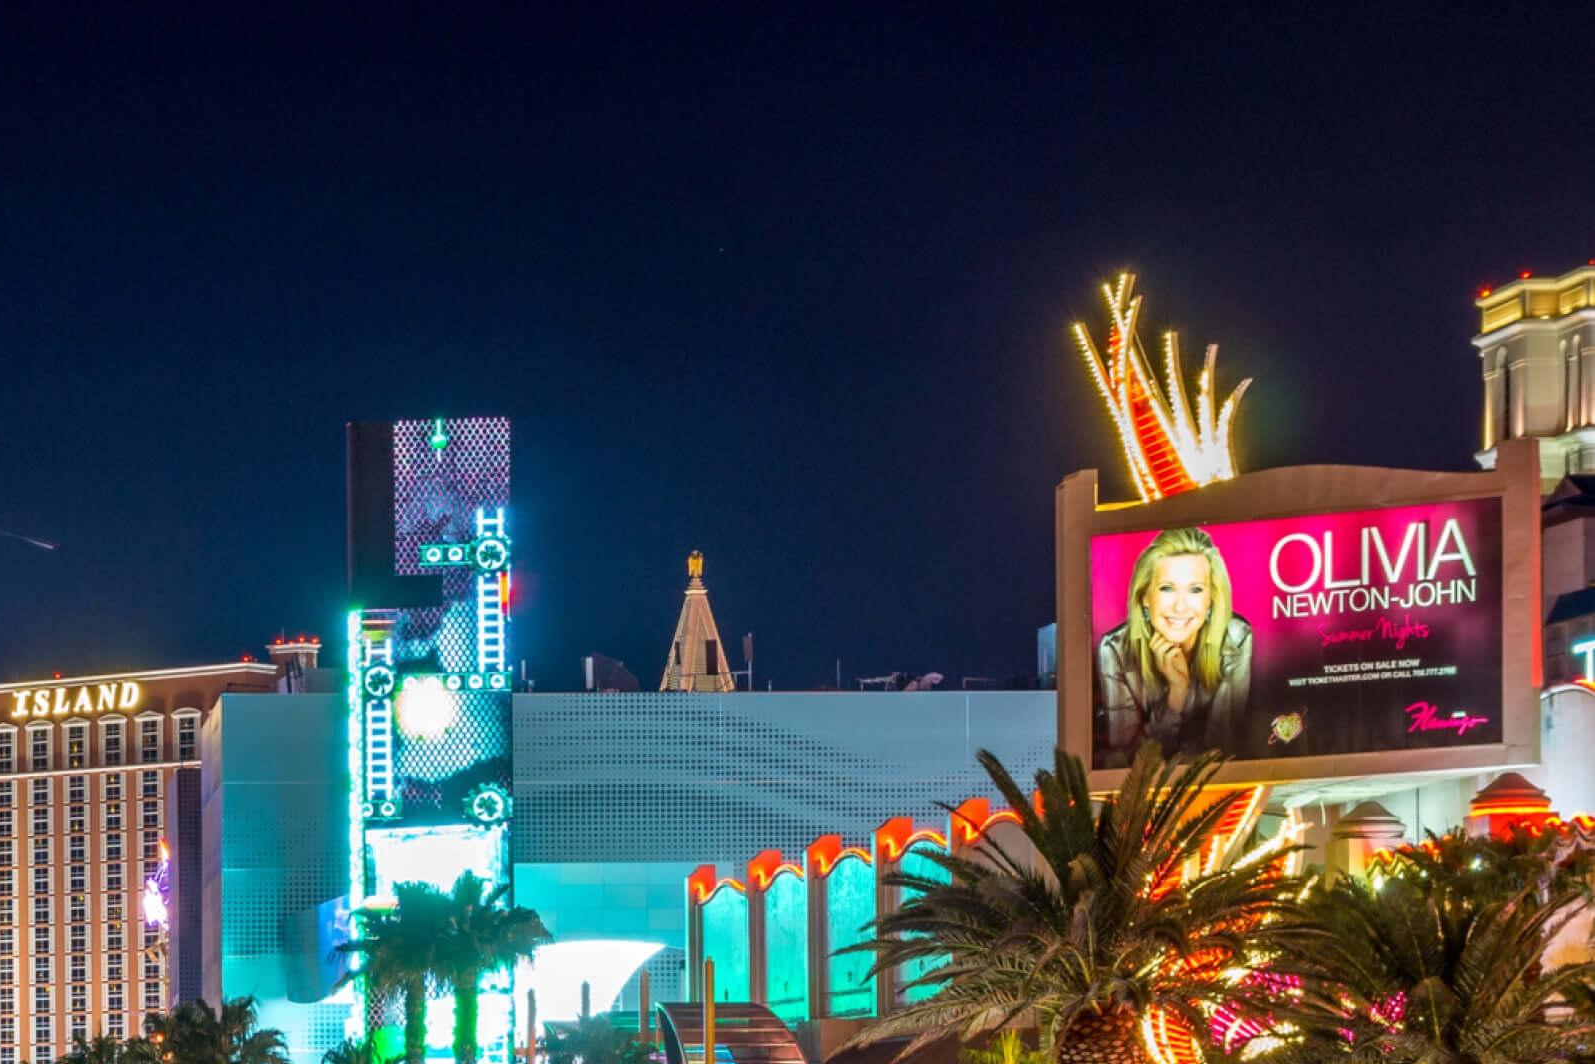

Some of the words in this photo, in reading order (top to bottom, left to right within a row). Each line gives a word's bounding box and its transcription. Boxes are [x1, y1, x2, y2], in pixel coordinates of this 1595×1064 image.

[1270, 518, 1476, 594] OLIVIA
[1272, 578, 1476, 619] NEWTON-JOHN
[1318, 624, 1373, 647] Summer
[1376, 614, 1429, 649] Nights
[1324, 663, 1360, 674] TICKETS
[1361, 662, 1374, 672] ON
[1375, 660, 1398, 670] SALE
[1399, 658, 1420, 668] NOW
[12, 681, 141, 718] ISLAND
